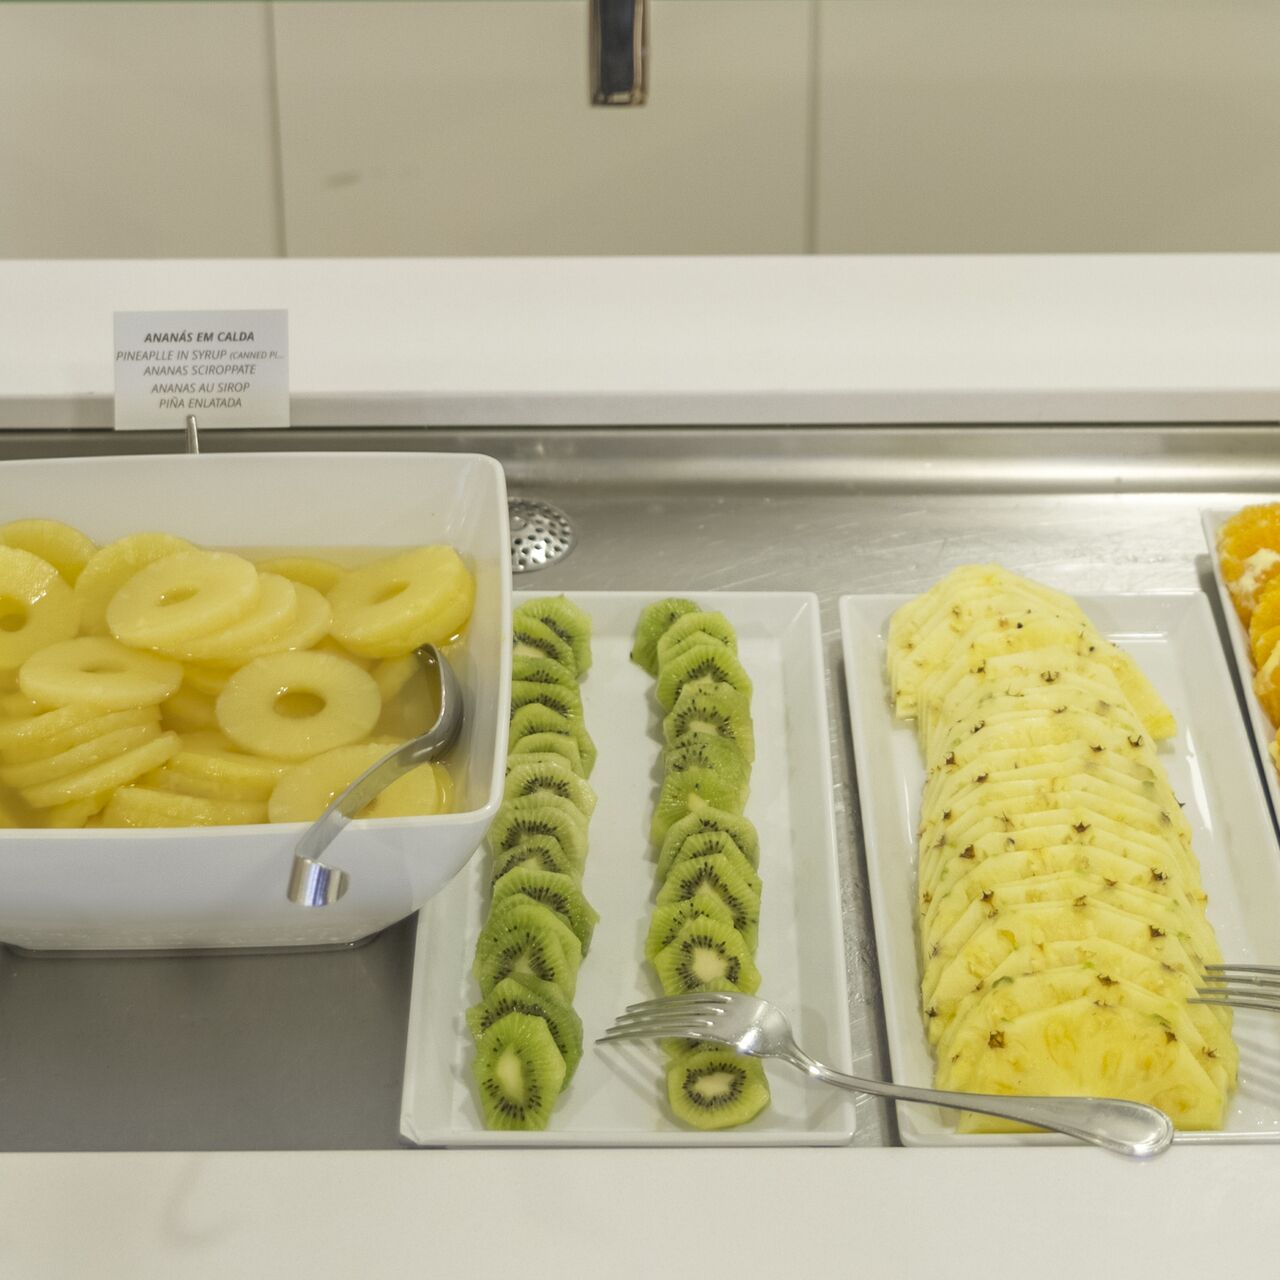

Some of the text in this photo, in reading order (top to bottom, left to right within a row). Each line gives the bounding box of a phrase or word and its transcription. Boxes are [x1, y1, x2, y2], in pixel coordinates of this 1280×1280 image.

[144, 330, 255, 343] ANANÁS EM CALDA
[116, 351, 174, 361] PINEAPLLE
[177, 350, 190, 360] IN
[192, 350, 227, 360] SYRUP
[143, 364, 256, 376] ANANAS SCIROPPATE
[151, 382, 250, 393] ANANAS AU SIROP
[159, 396, 242, 408] PIÑA ENLATADA
